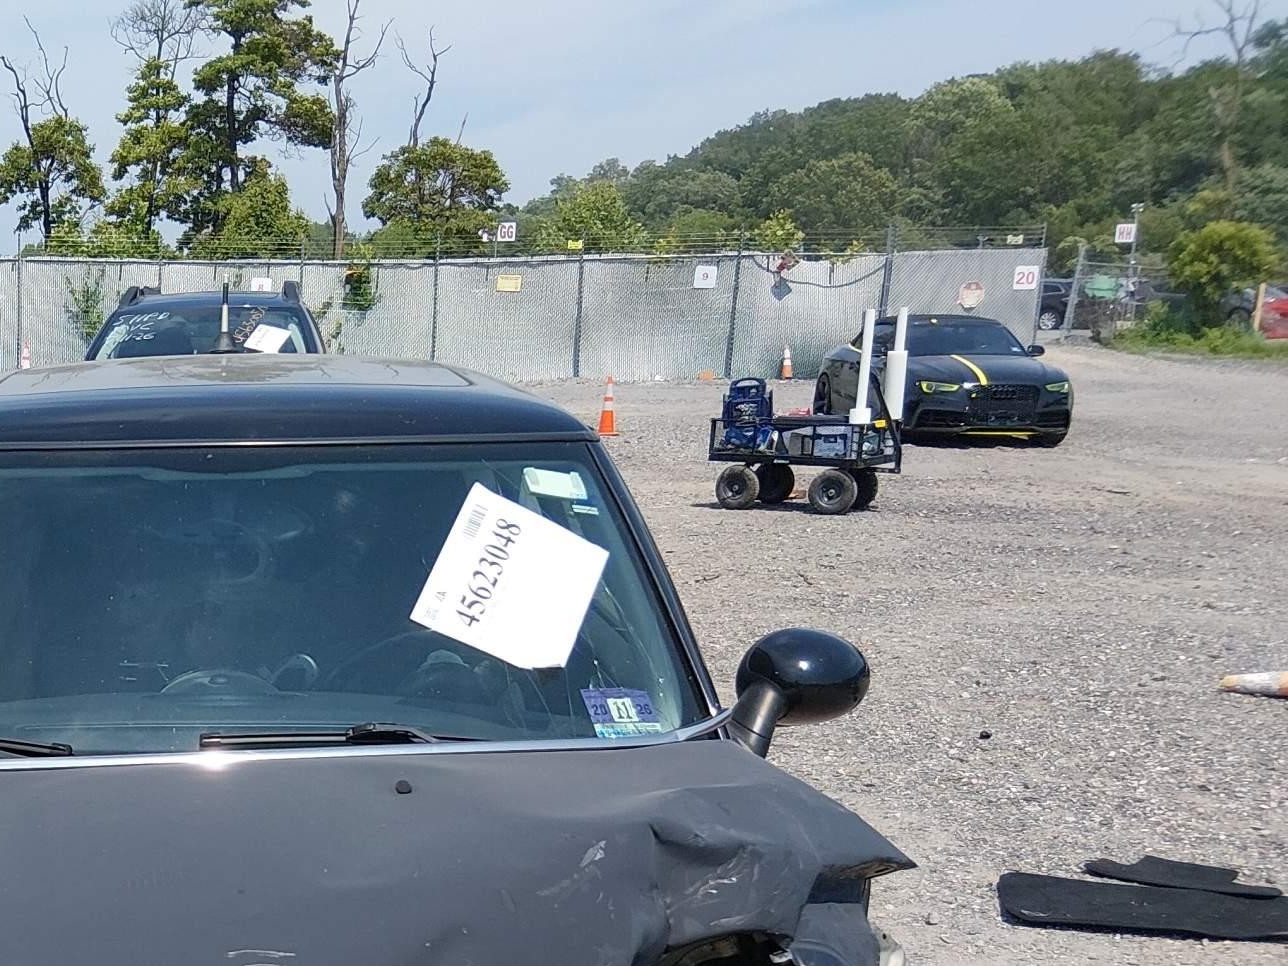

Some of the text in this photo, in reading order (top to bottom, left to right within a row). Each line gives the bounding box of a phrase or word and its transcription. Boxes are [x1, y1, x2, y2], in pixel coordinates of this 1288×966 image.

[499, 224, 514, 239] GG
[1016, 271, 1035, 285] 20
[456, 518, 521, 627] 45623048
[591, 704, 608, 716] 20
[636, 704, 653, 715] 26
